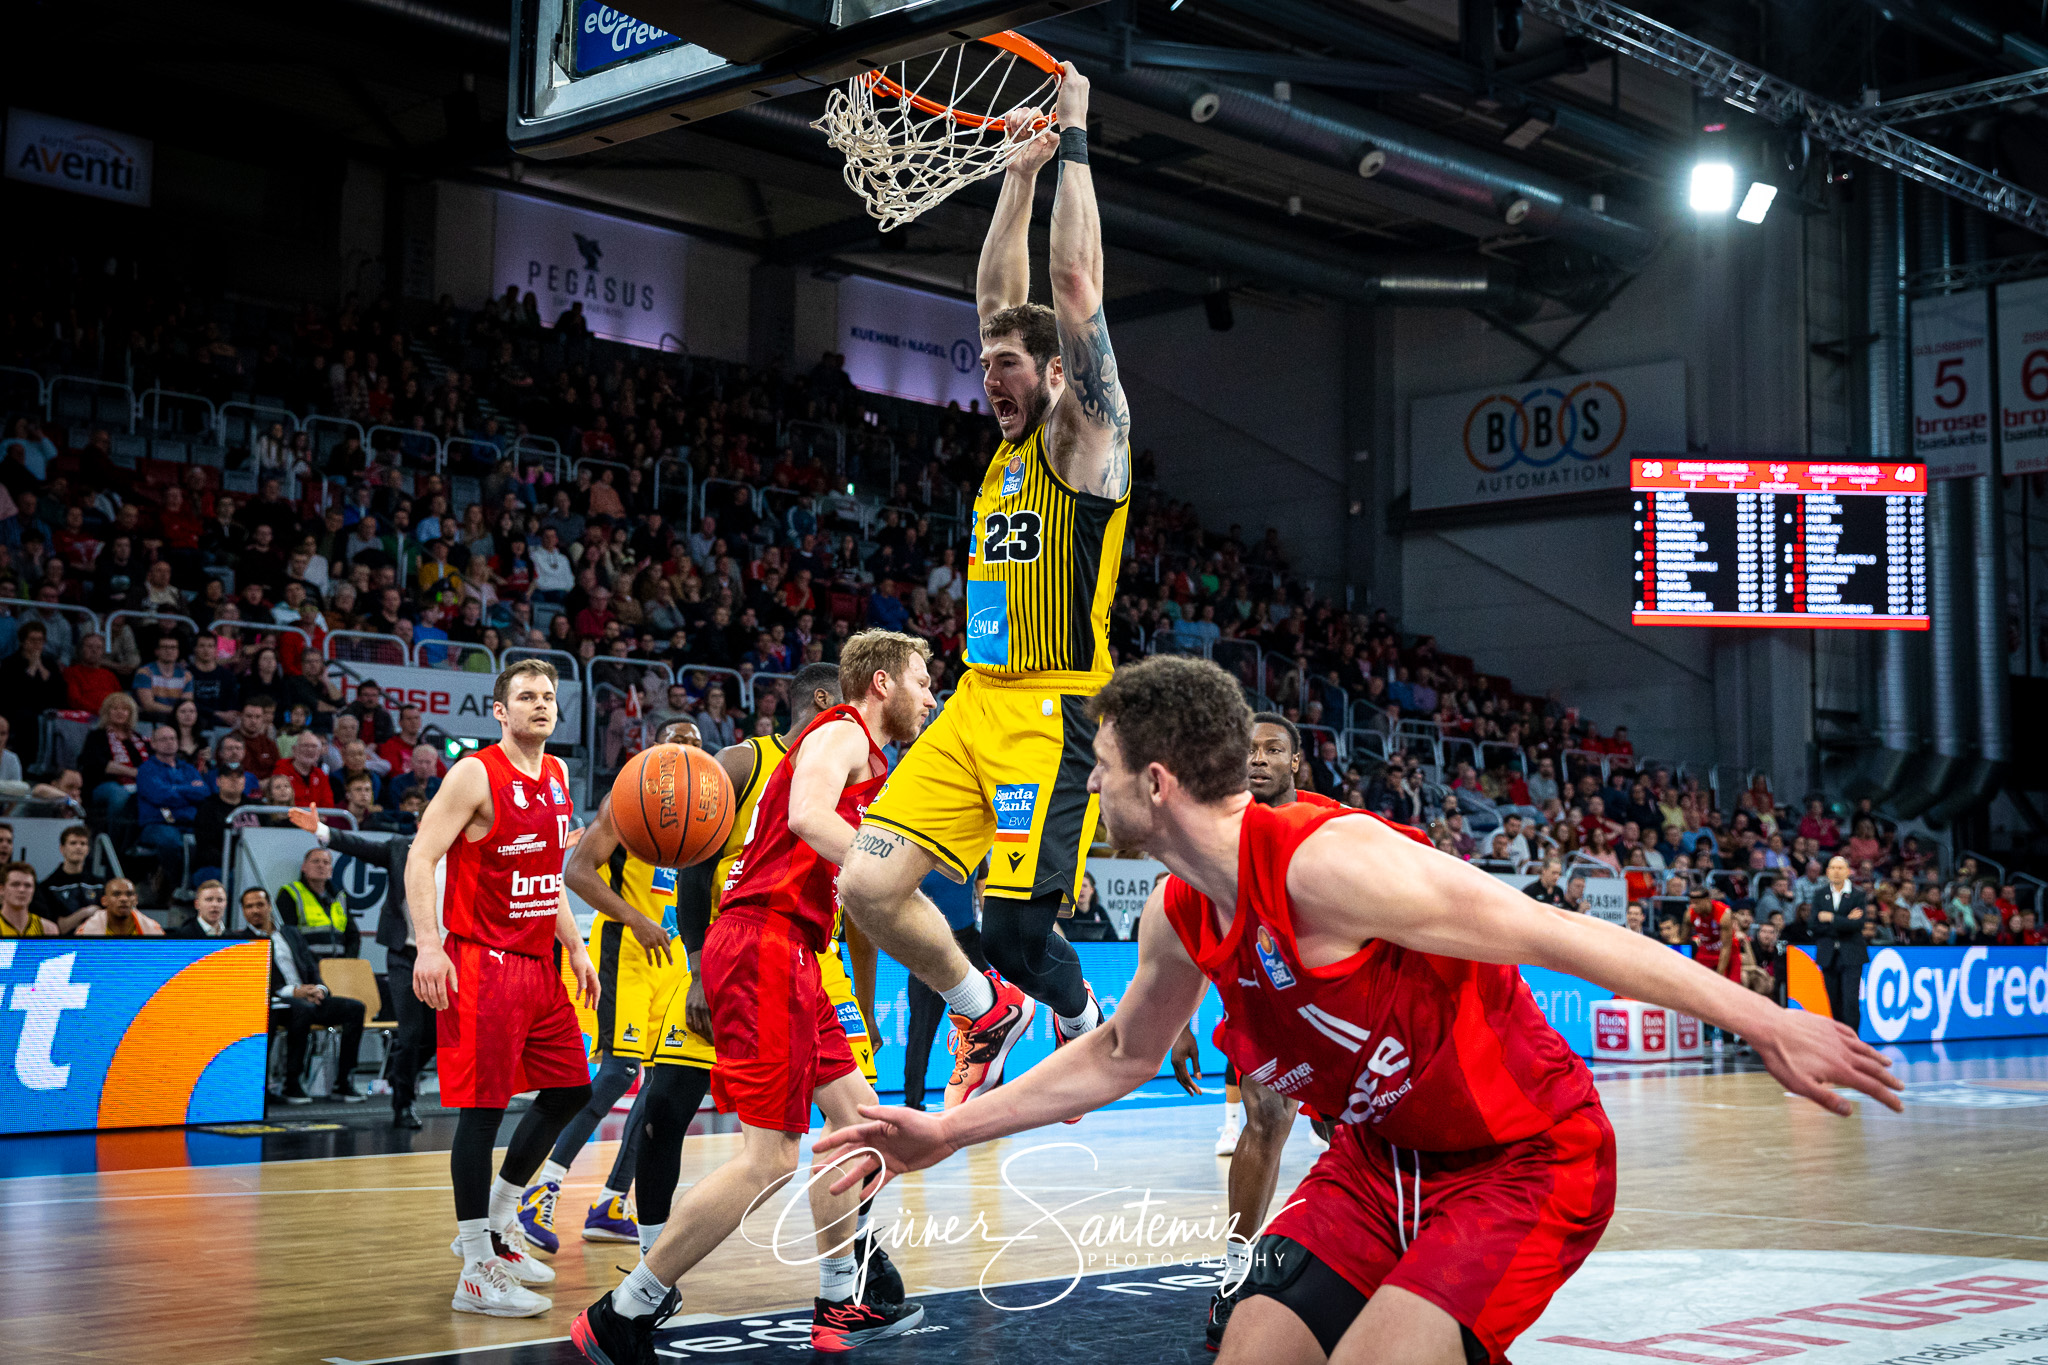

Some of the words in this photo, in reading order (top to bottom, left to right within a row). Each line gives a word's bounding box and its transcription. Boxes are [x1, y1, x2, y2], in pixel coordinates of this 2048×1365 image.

[528, 259, 654, 311] PEGASUS
[1933, 357, 1968, 409] 5
[2021, 349, 2048, 403] 6
[1916, 413, 1988, 435] brose
[2004, 408, 2048, 427] bro
[1916, 432, 1988, 451] baskets
[2004, 426, 2048, 442] bamb
[1475, 463, 1612, 496] AUTOMATION
[983, 510, 1043, 564] 23
[973, 619, 1000, 635] SWLB
[659, 751, 679, 829] SPALDING
[556, 814, 569, 850] 17
[1008, 817, 1030, 827] BW
[511, 870, 563, 896] bros
[1107, 878, 1150, 896] IGAR
[509, 910, 523, 919] der
[1107, 898, 1144, 911] MOTOR
[1586, 894, 1624, 909] RASHI
[1859, 946, 2048, 1041] @syCred
[1297, 1003, 1371, 1053] 11
[1267, 1062, 1314, 1093] PARTNER
